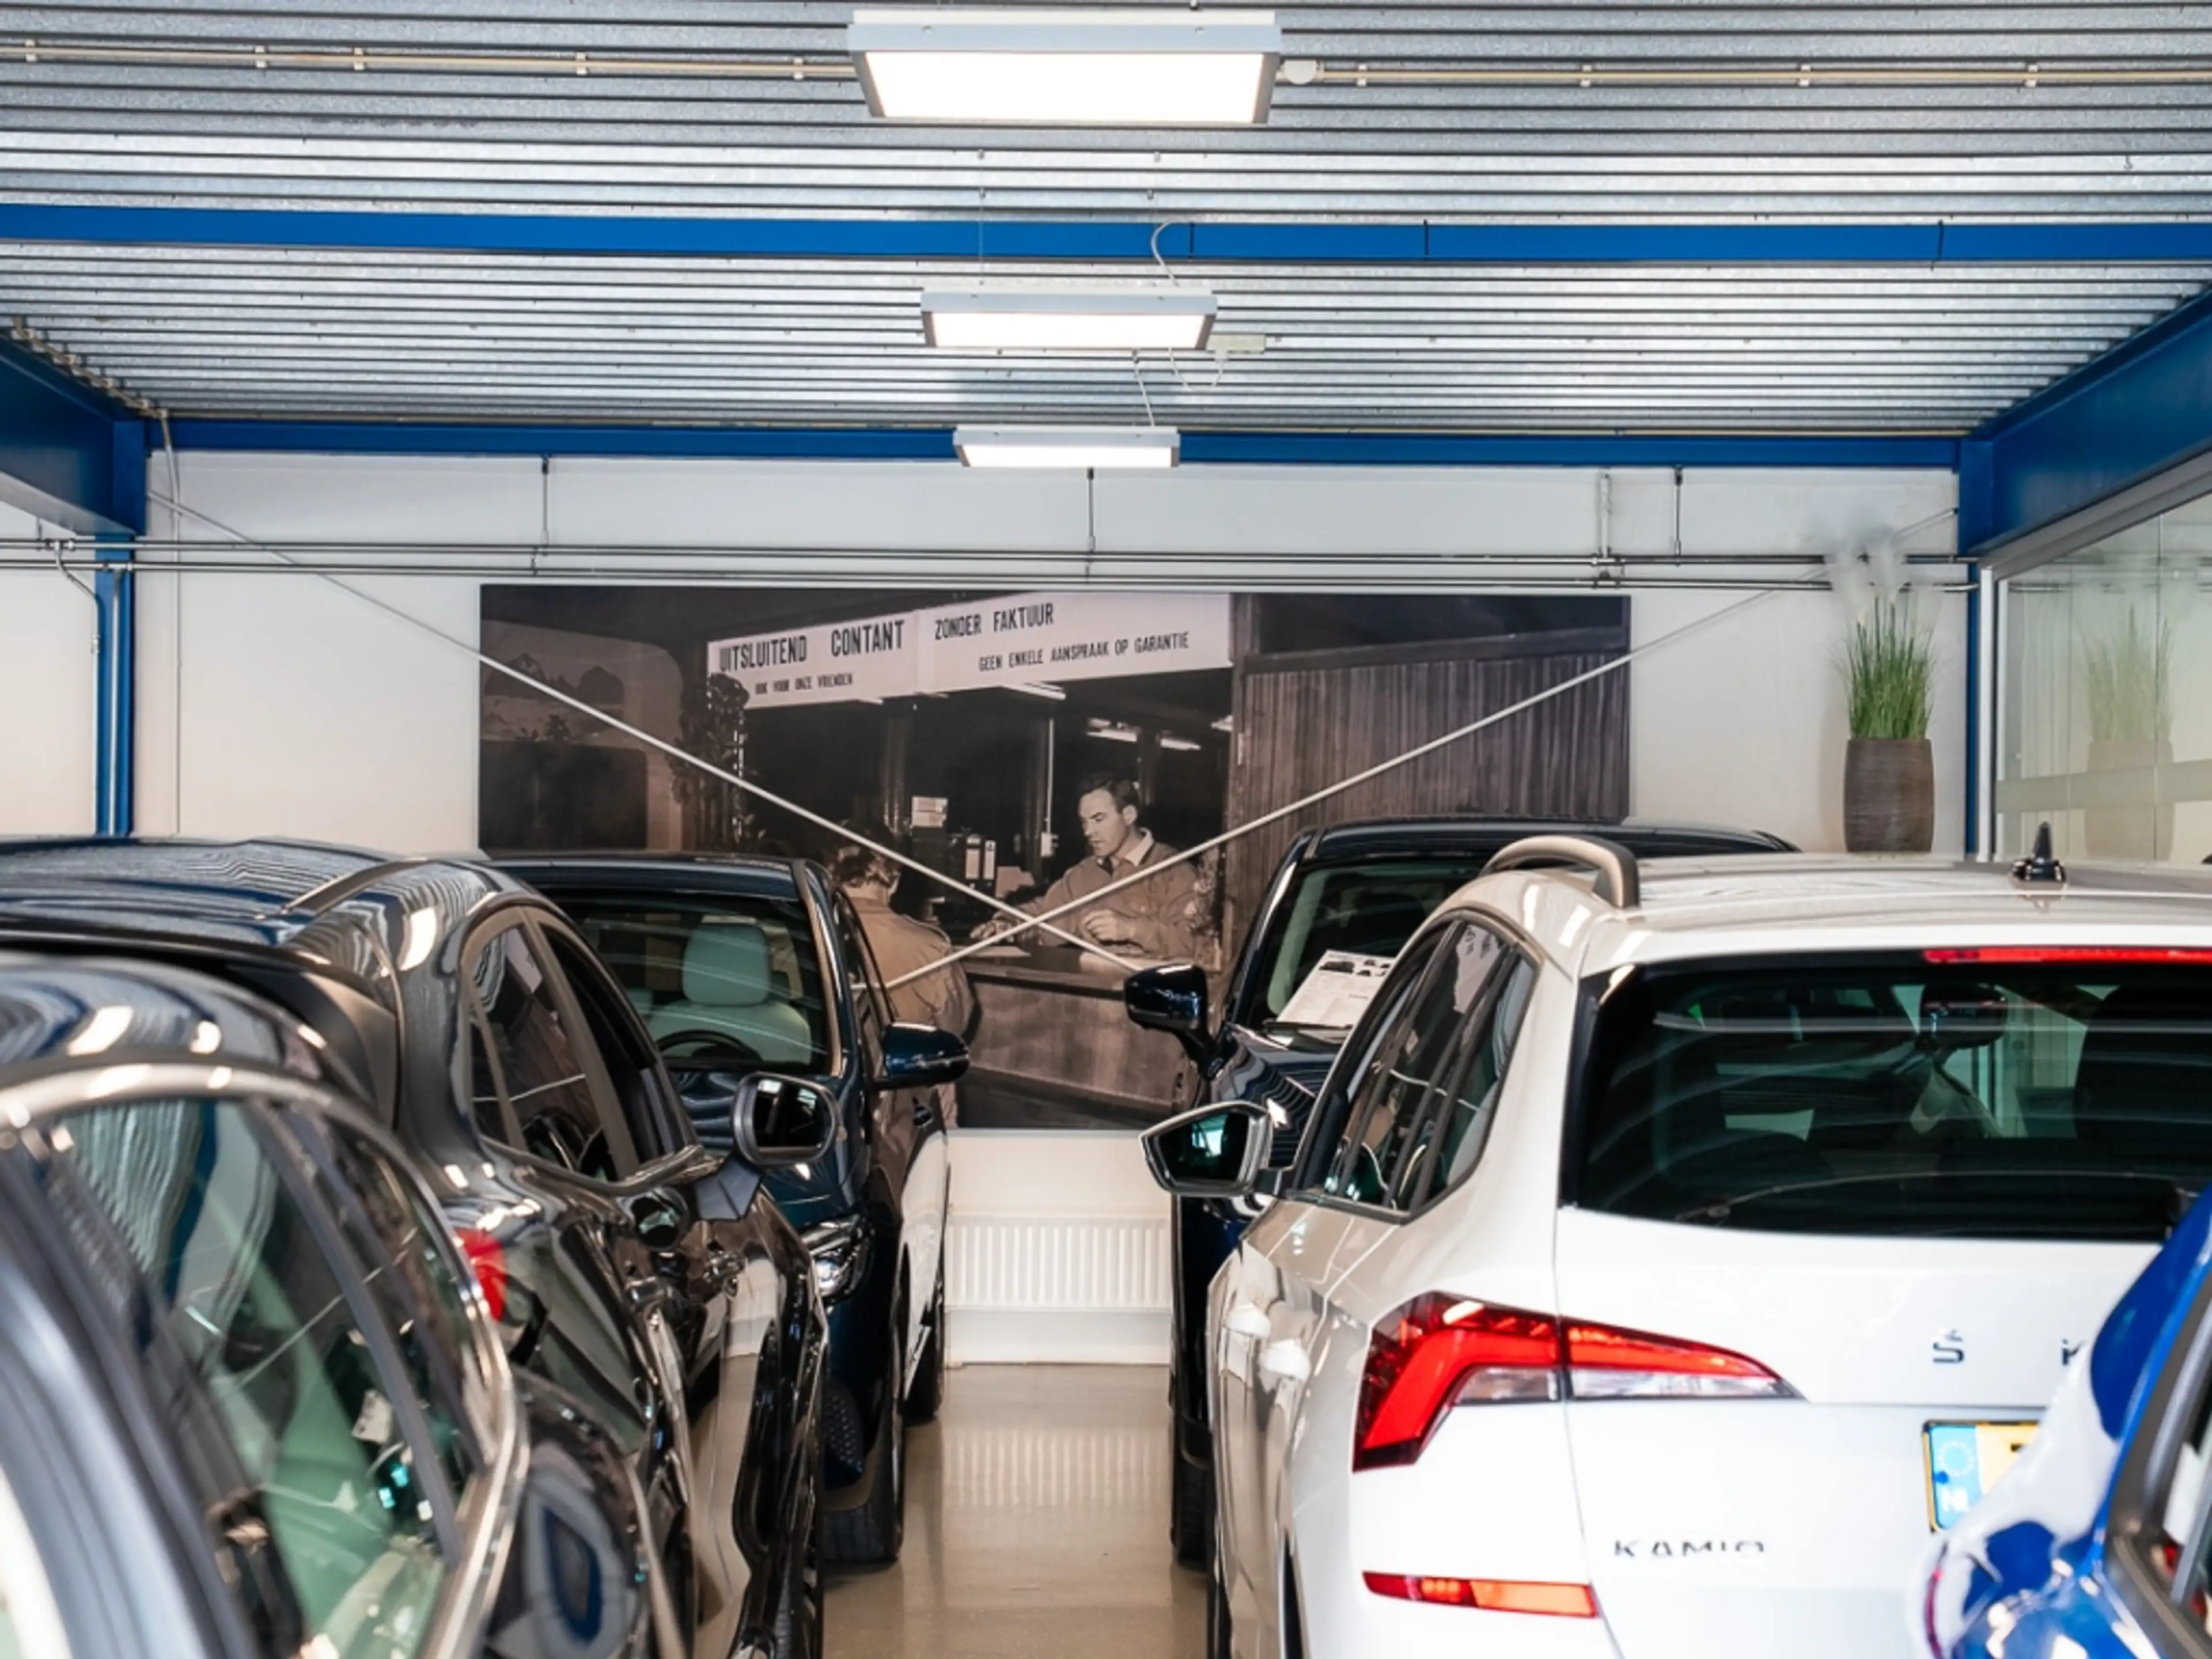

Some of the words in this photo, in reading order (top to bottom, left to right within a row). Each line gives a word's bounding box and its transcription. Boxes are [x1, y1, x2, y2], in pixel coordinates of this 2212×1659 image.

[935, 614, 982, 640] ZONDER
[993, 602, 1054, 632] FAKTUUR
[719, 635, 808, 672] UITSLUITEND
[831, 619, 905, 657] CONTANT
[979, 655, 1002, 672] GEEN
[1009, 649, 1044, 668] ENKELE
[1051, 641, 1109, 662] AANSPRAAK
[1114, 638, 1128, 656] OP
[1134, 631, 1189, 653] GARANTIE
